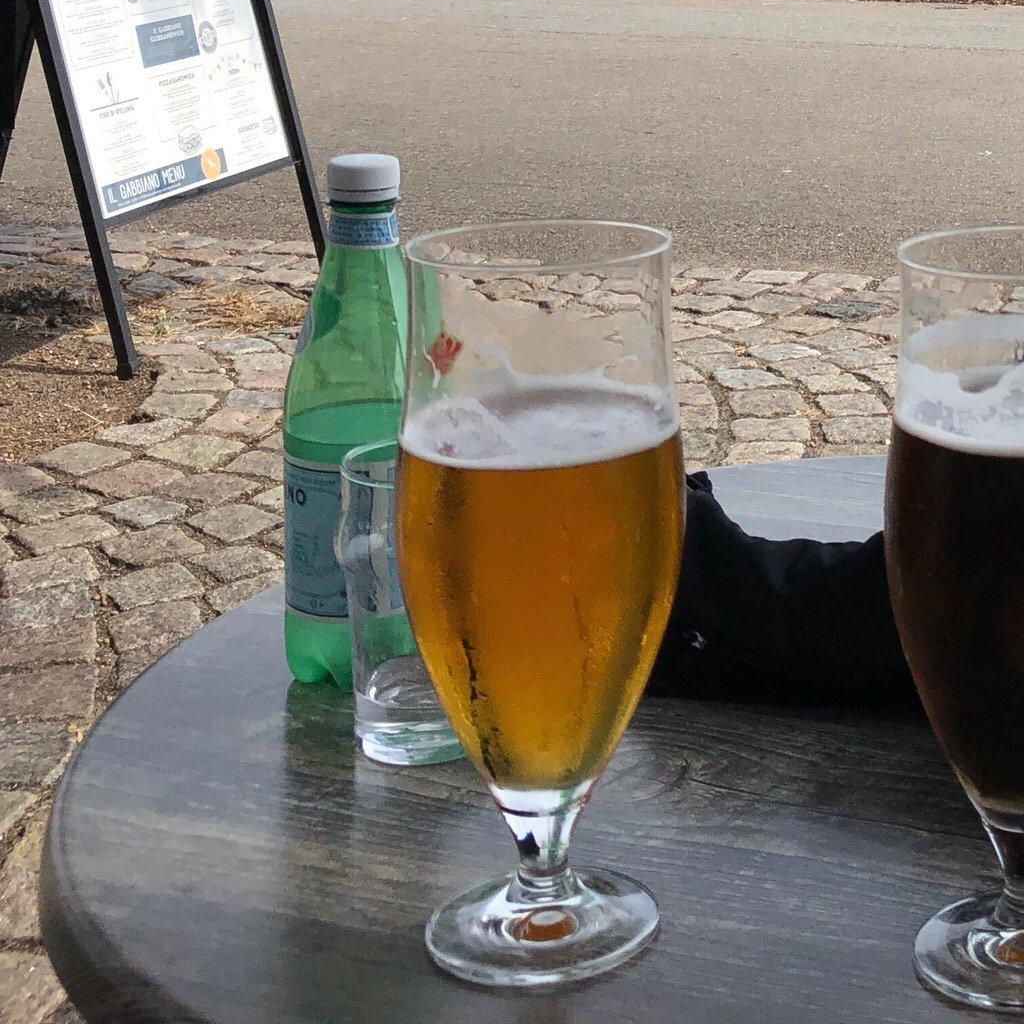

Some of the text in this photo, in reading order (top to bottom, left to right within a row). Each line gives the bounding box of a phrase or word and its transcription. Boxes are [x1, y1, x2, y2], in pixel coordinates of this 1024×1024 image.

[107, 187, 118, 204] IL
[119, 173, 160, 200] GABBIANO
[161, 164, 186, 185] MENU
